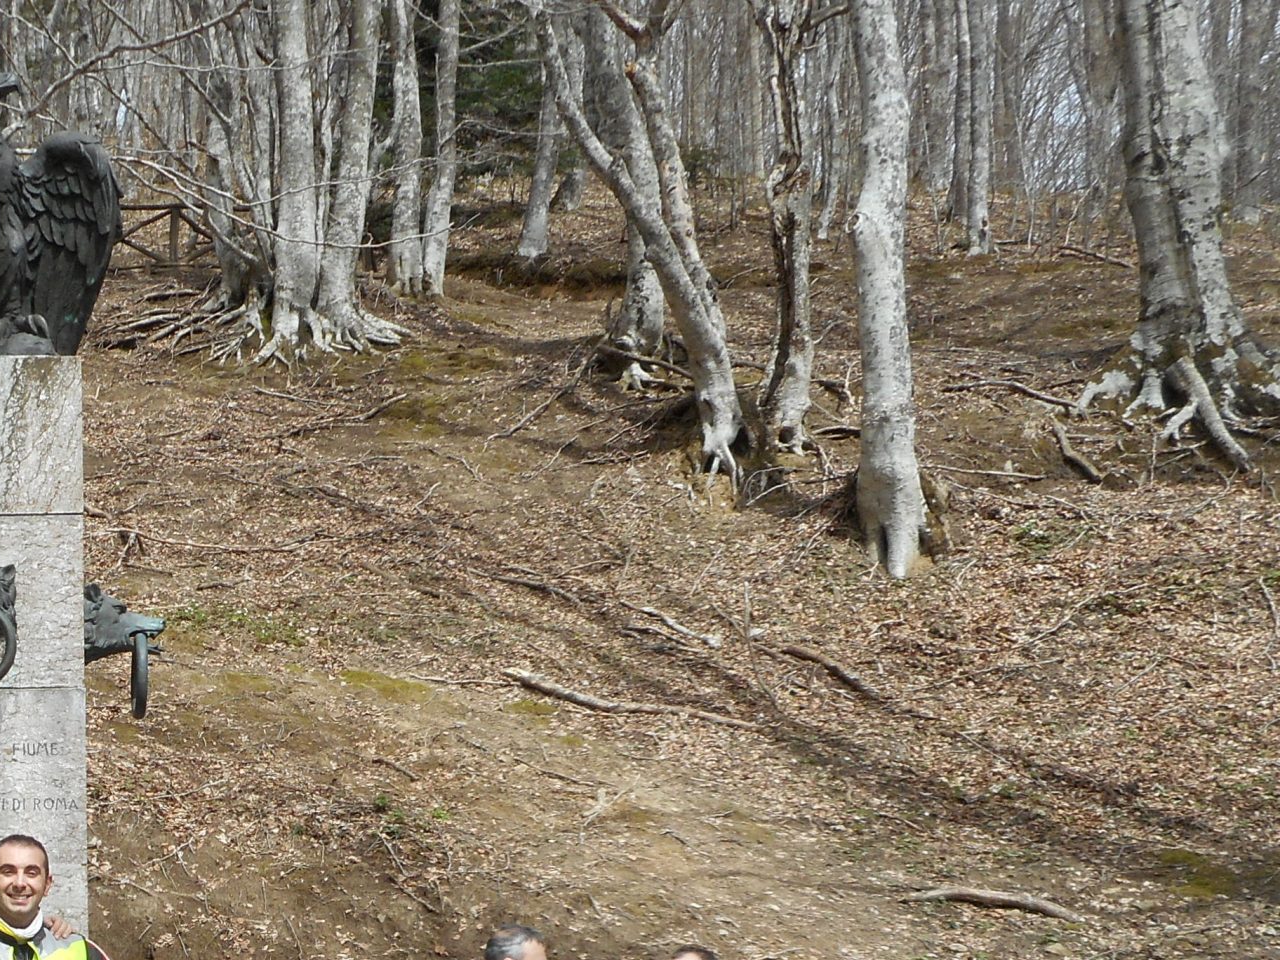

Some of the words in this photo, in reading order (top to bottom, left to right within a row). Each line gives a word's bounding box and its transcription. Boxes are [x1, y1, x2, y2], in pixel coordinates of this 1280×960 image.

[12, 742, 58, 757] FIUME
[12, 798, 26, 811] DI
[33, 797, 79, 811] ROMA
